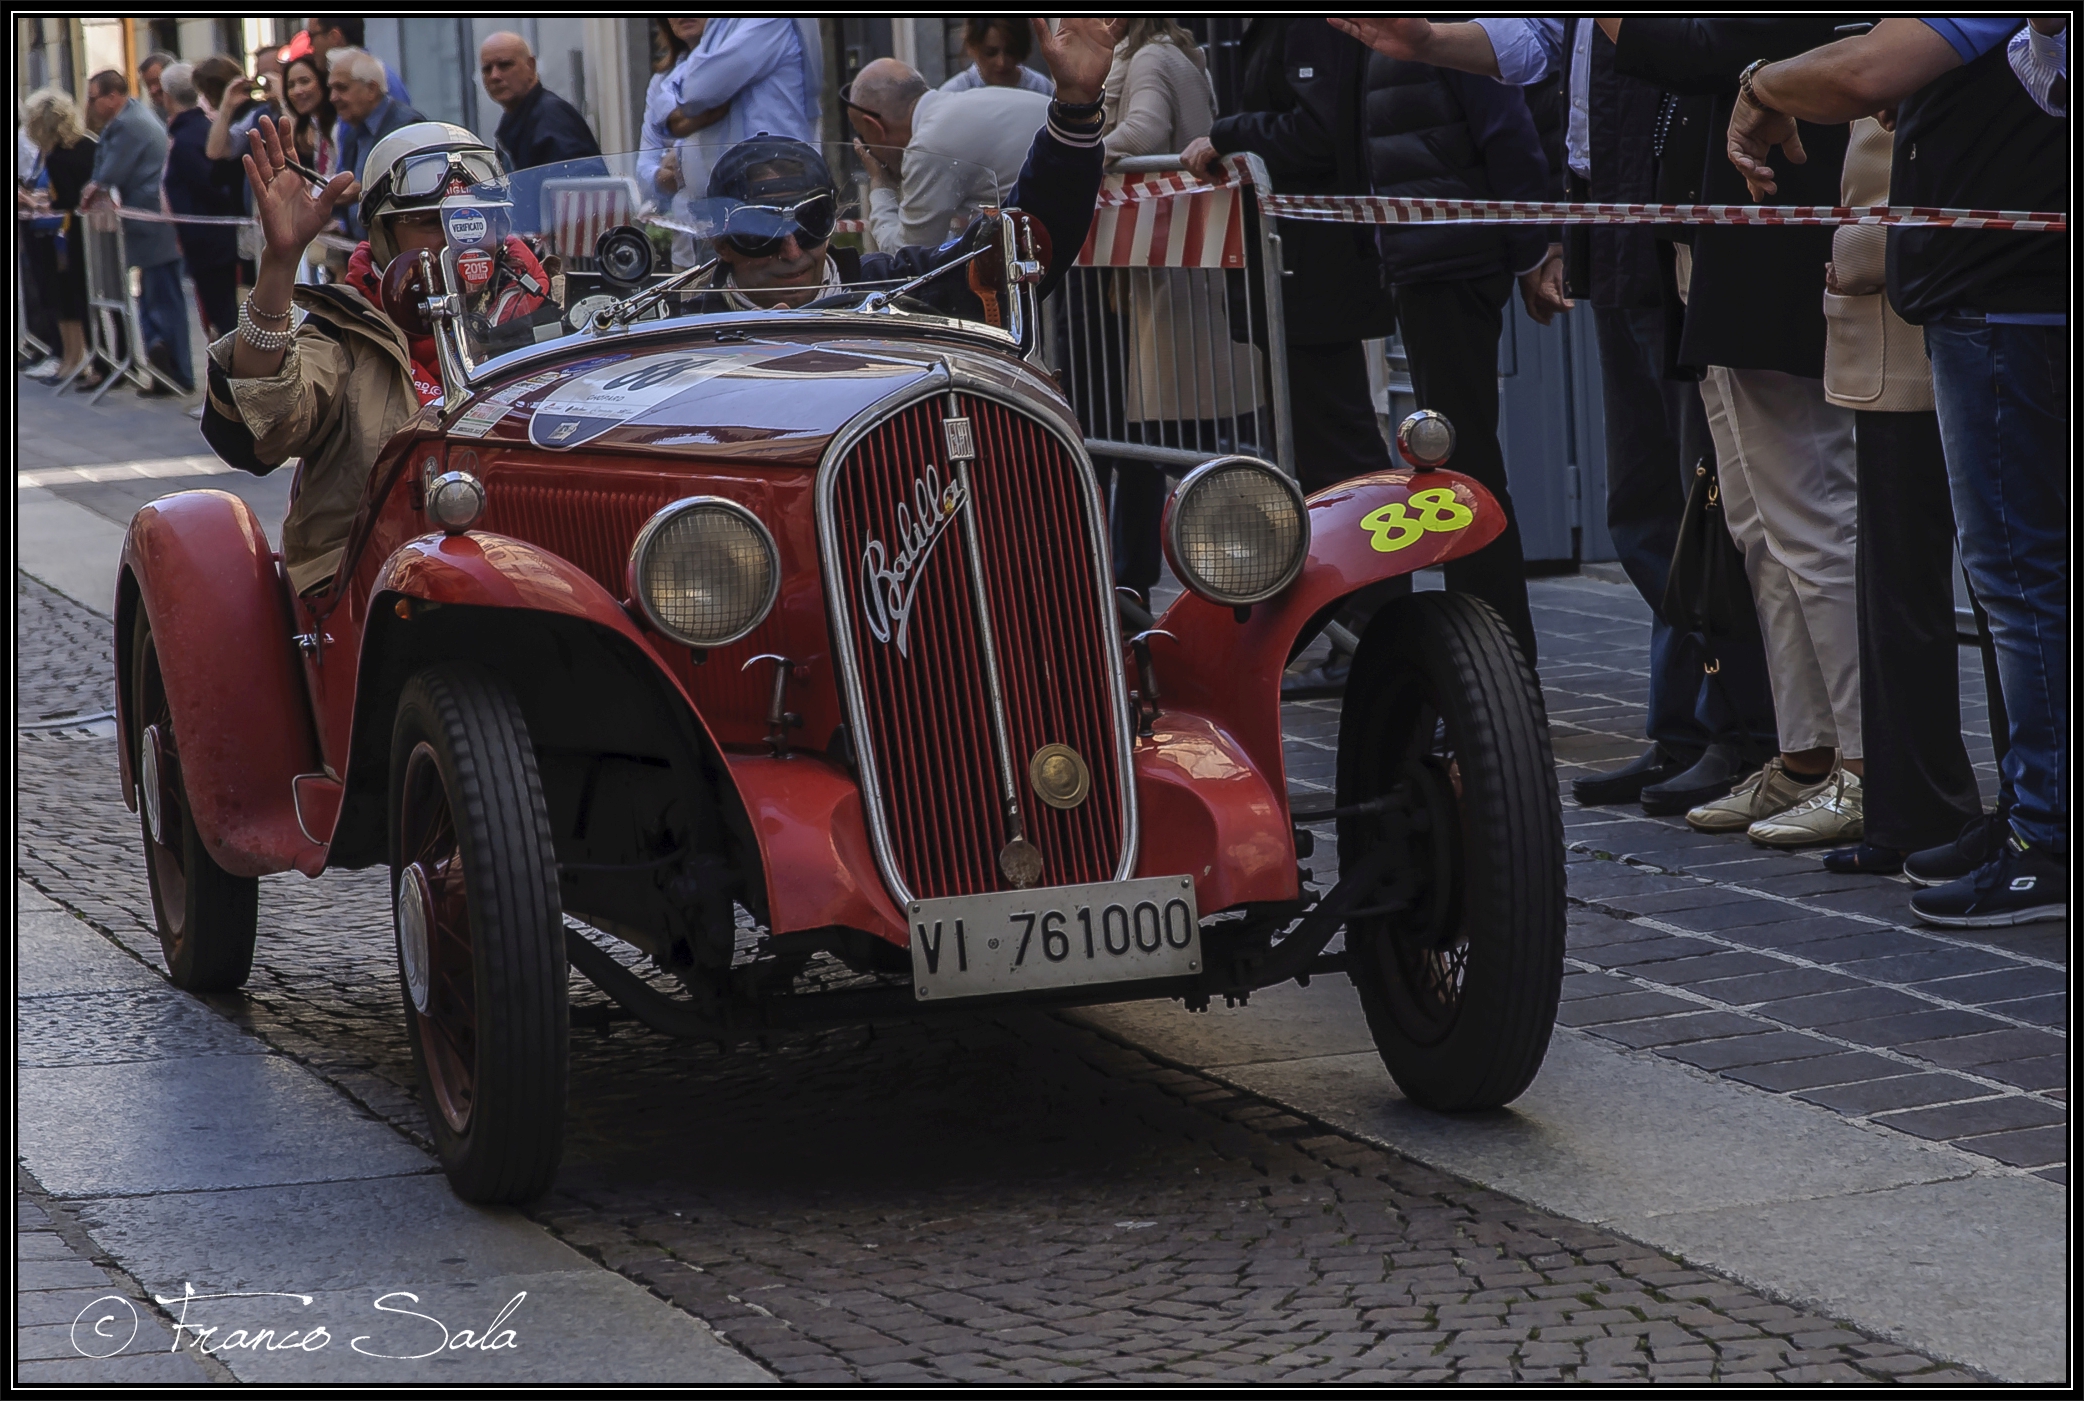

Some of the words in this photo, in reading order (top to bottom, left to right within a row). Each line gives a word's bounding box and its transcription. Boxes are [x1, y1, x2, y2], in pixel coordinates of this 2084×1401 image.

[452, 222, 484, 233] VERIFICATO
[464, 262, 489, 275] 2015
[1360, 488, 1474, 553] 88
[861, 464, 968, 659] Balilla
[917, 918, 967, 975] VI
[1009, 898, 1192, 966] 761000
